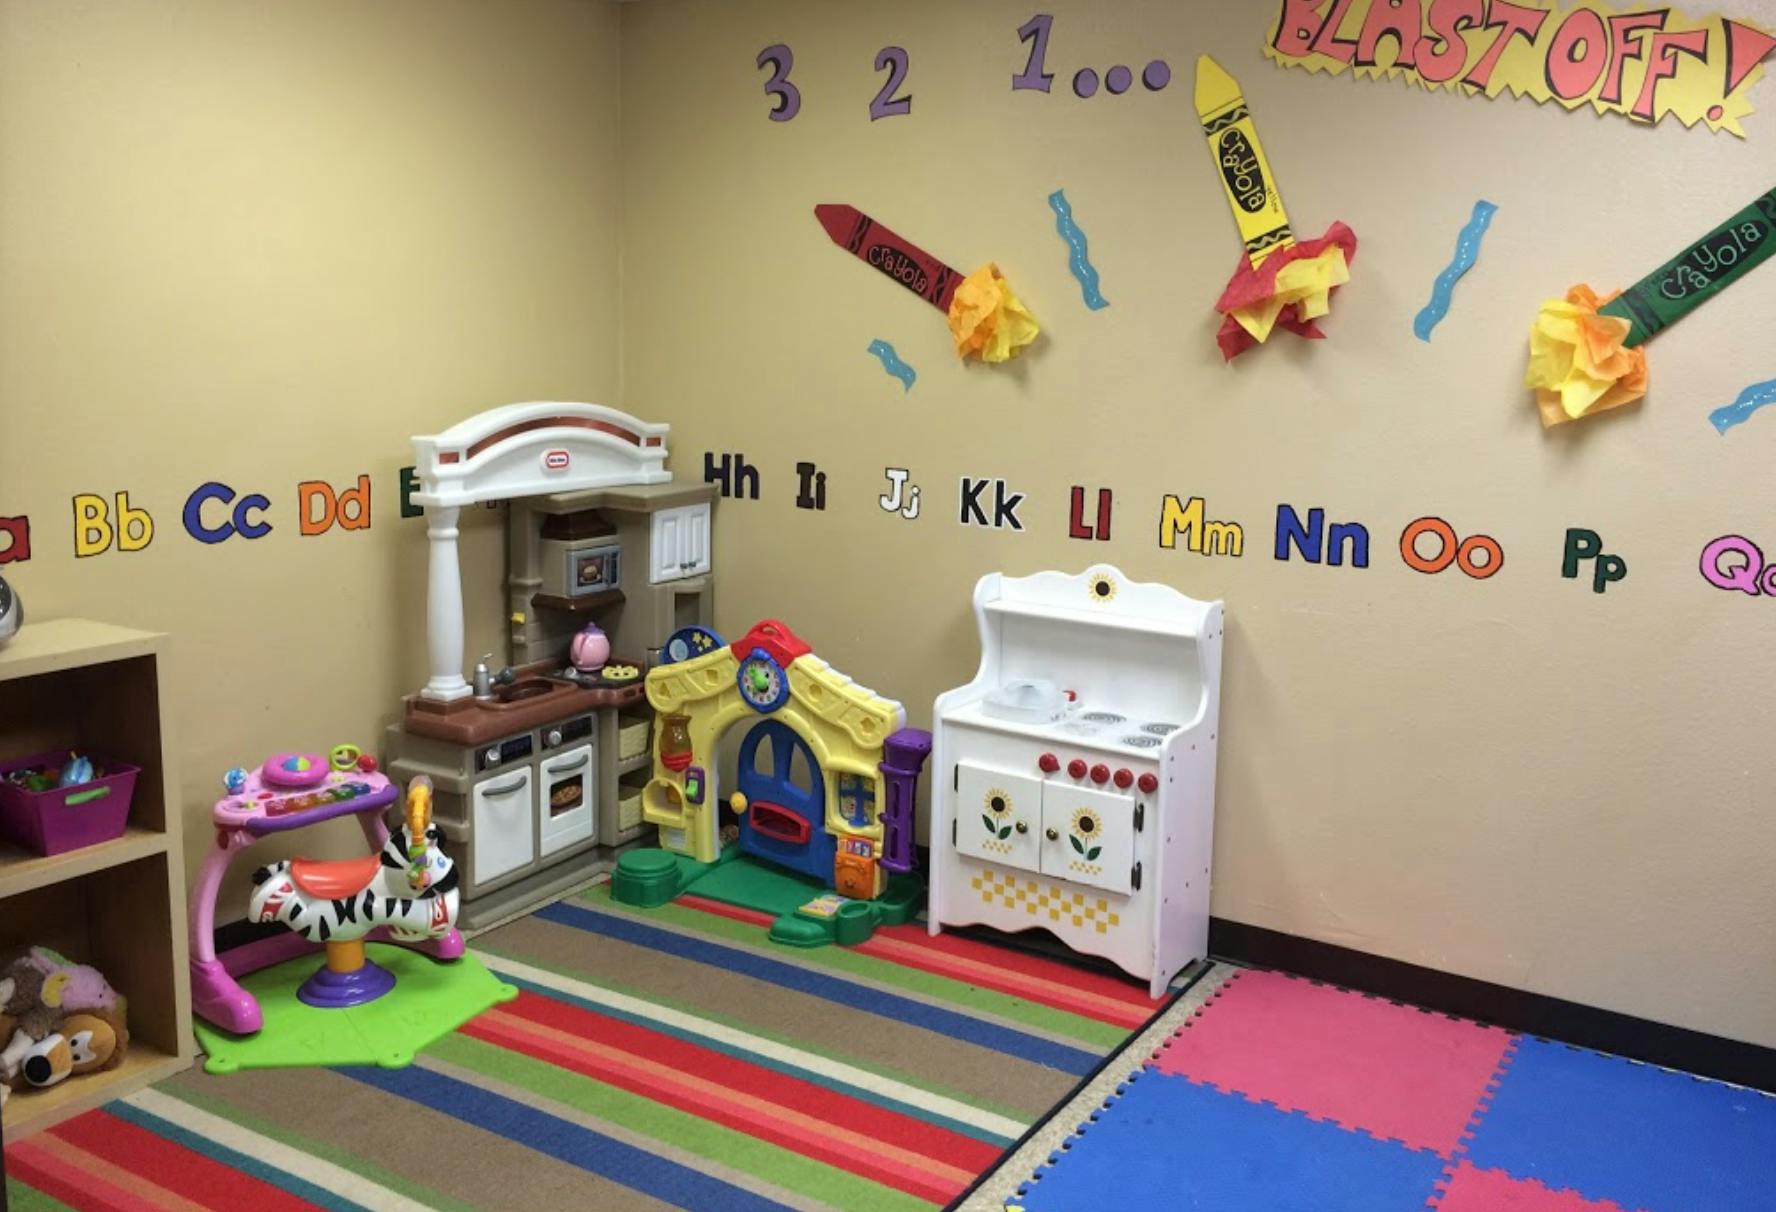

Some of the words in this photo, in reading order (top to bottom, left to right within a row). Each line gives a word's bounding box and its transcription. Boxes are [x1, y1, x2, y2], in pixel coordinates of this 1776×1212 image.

[756, 43, 800, 122] 3
[868, 46, 912, 121] 2
[1272, 0, 1550, 91] BLAST
[1544, 7, 1776, 123] OFF!
[1221, 128, 1265, 210] Crayola
[868, 245, 927, 293] Crayola
[1661, 222, 1762, 299] Crayola
[72, 491, 154, 558] Bb
[182, 482, 272, 544] Cc
[298, 475, 371, 536] Dd
[704, 452, 759, 500] Hh
[796, 462, 826, 510] Ii
[879, 467, 920, 519] Jj
[960, 477, 1026, 530] Kk
[1069, 485, 1112, 541] Ll
[1159, 494, 1243, 557] Mm
[1274, 504, 1369, 569] Nn
[1400, 516, 1504, 579] Oo
[1561, 528, 1627, 594] Pp
